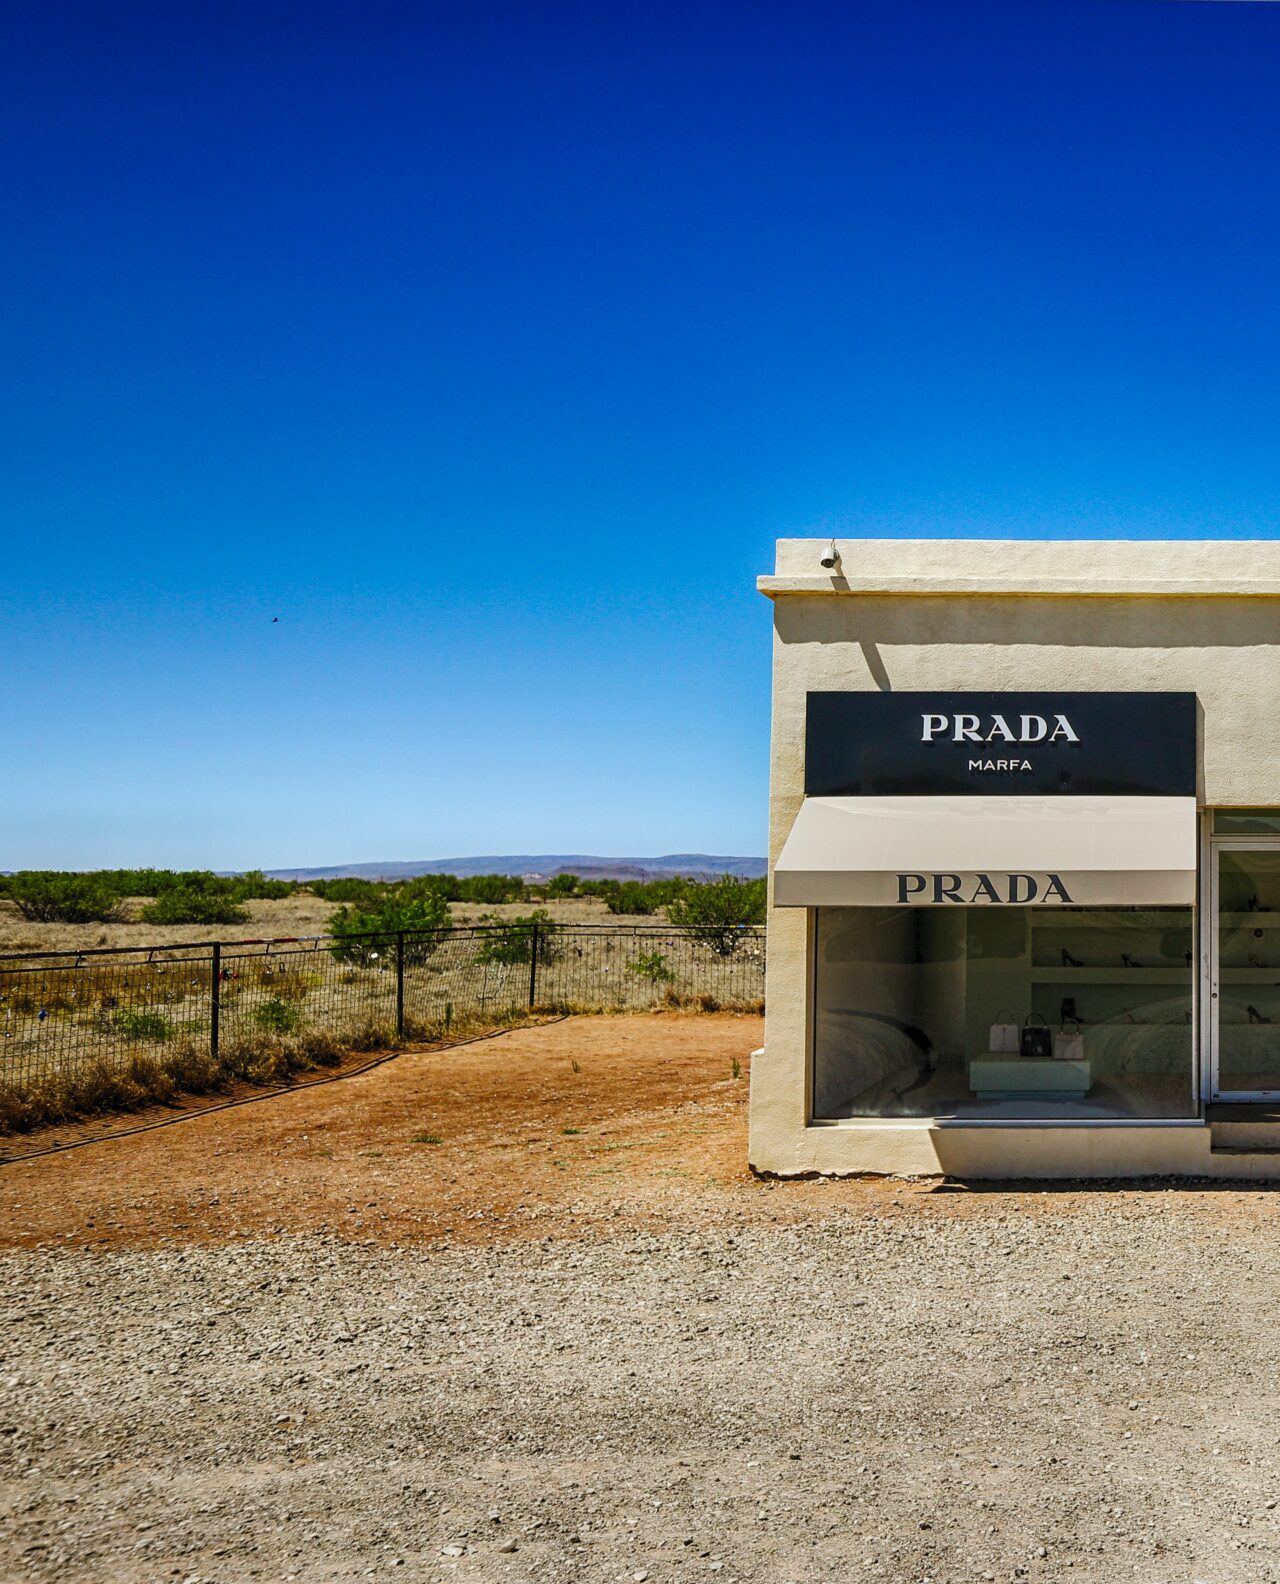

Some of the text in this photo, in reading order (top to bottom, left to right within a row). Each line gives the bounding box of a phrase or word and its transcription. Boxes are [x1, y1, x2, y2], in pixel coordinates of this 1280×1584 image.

[921, 715, 1080, 742] PRADA
[969, 760, 1032, 771] MARFA
[896, 874, 1075, 904] PRADA
